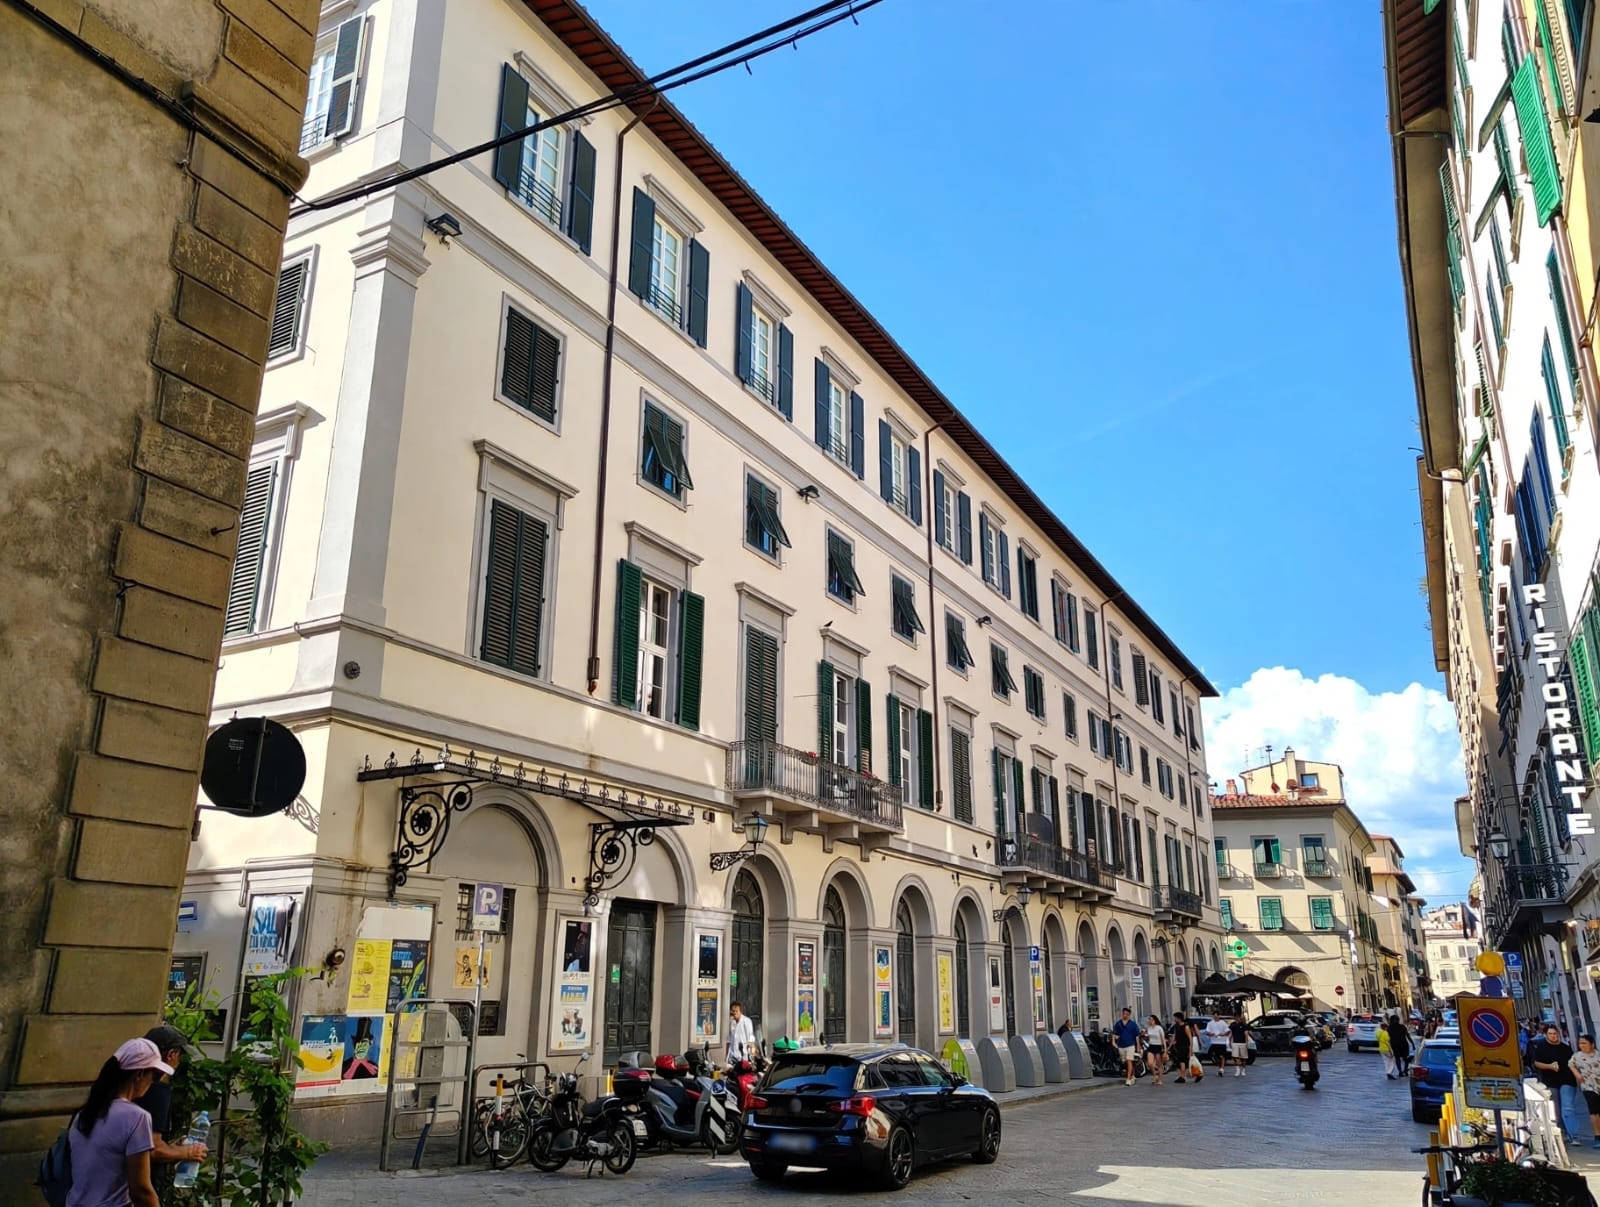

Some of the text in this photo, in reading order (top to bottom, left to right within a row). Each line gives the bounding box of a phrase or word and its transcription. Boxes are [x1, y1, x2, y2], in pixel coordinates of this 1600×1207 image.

[1522, 584, 1596, 836] RISTORANTE
[481, 887, 497, 913] P
[1031, 947, 1038, 960] P
[1508, 953, 1517, 966] P
